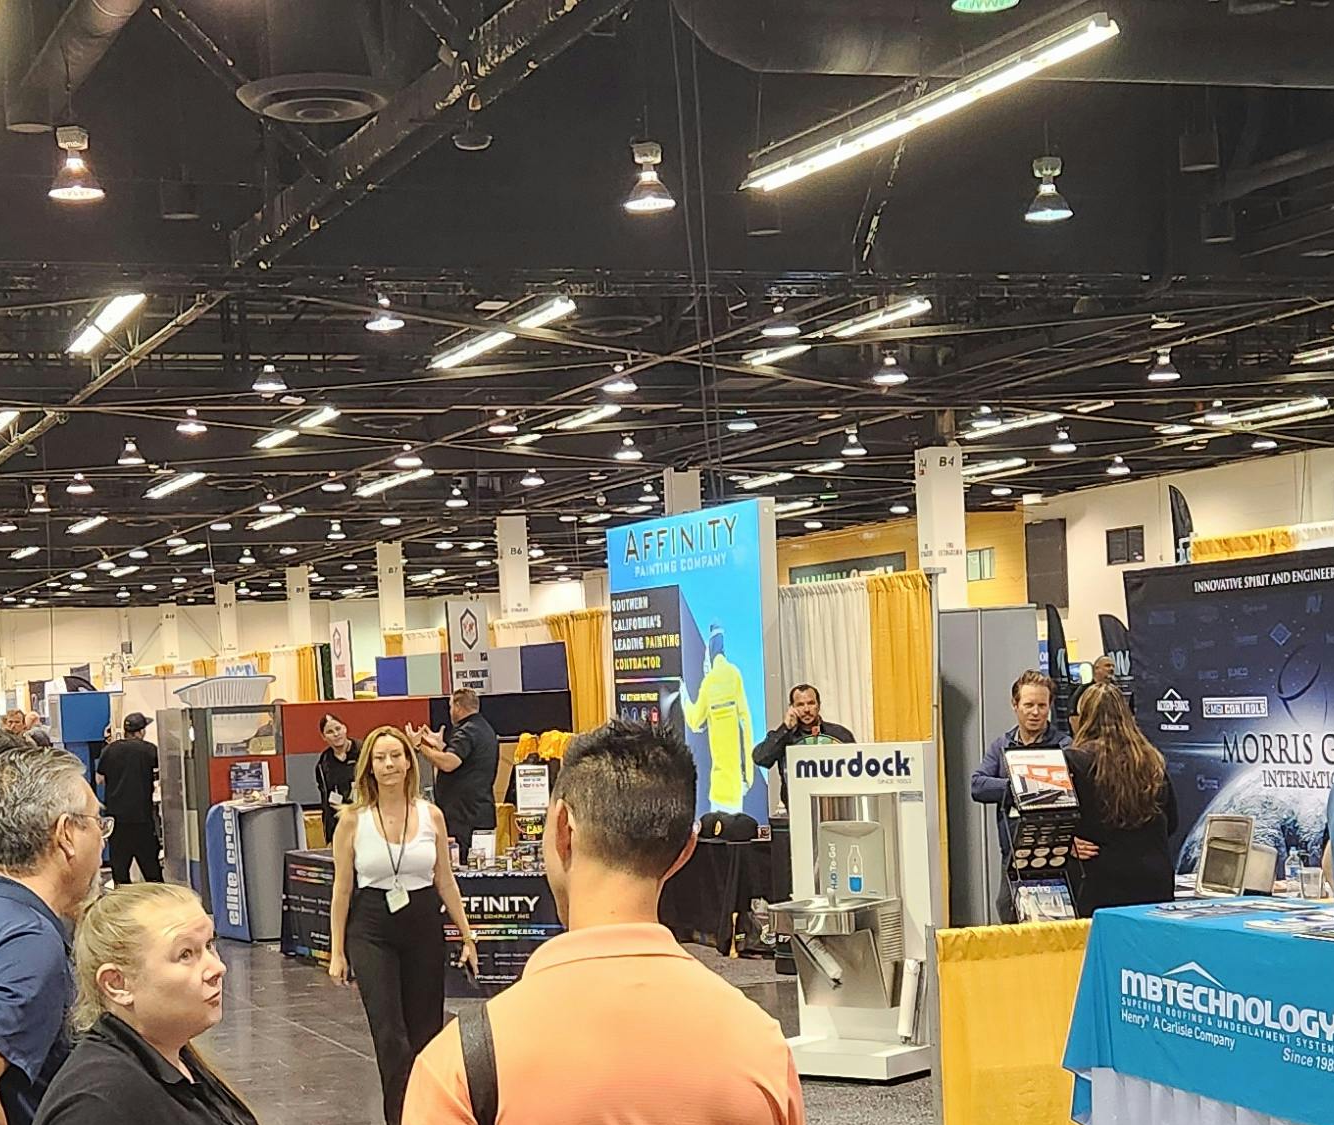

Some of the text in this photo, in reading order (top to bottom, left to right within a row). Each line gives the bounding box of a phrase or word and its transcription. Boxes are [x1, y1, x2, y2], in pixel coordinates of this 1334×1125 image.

[939, 456, 954, 467] B4
[625, 515, 738, 565] AFFINITY
[634, 551, 727, 578] PAINTING COMPANY
[1194, 576, 1243, 593] INNOVATIVE
[1244, 573, 1270, 588] SPIRIT
[1270, 571, 1292, 585] AND
[612, 596, 649, 612] SOUTHERN
[613, 615, 662, 631] CALIFORNIA'S
[614, 634, 680, 651] LEADING PAINTING
[615, 656, 662, 671] CONTRACTOR
[1221, 732, 1313, 765] MORRIS
[795, 750, 911, 778] murdock
[226, 872, 240, 927] elite
[1121, 996, 1162, 1014] SUPERIOR
[1166, 1007, 1203, 1024] ROOFING
[1207, 1017, 1213, 1026] &
[1217, 1019, 1291, 1044] UNDERLAYMENT
[1153, 1015, 1160, 1028] A
[1160, 1018, 1193, 1039] Carlisle
[1194, 1026, 1235, 1050] Company
[1282, 1047, 1314, 1068] Since
